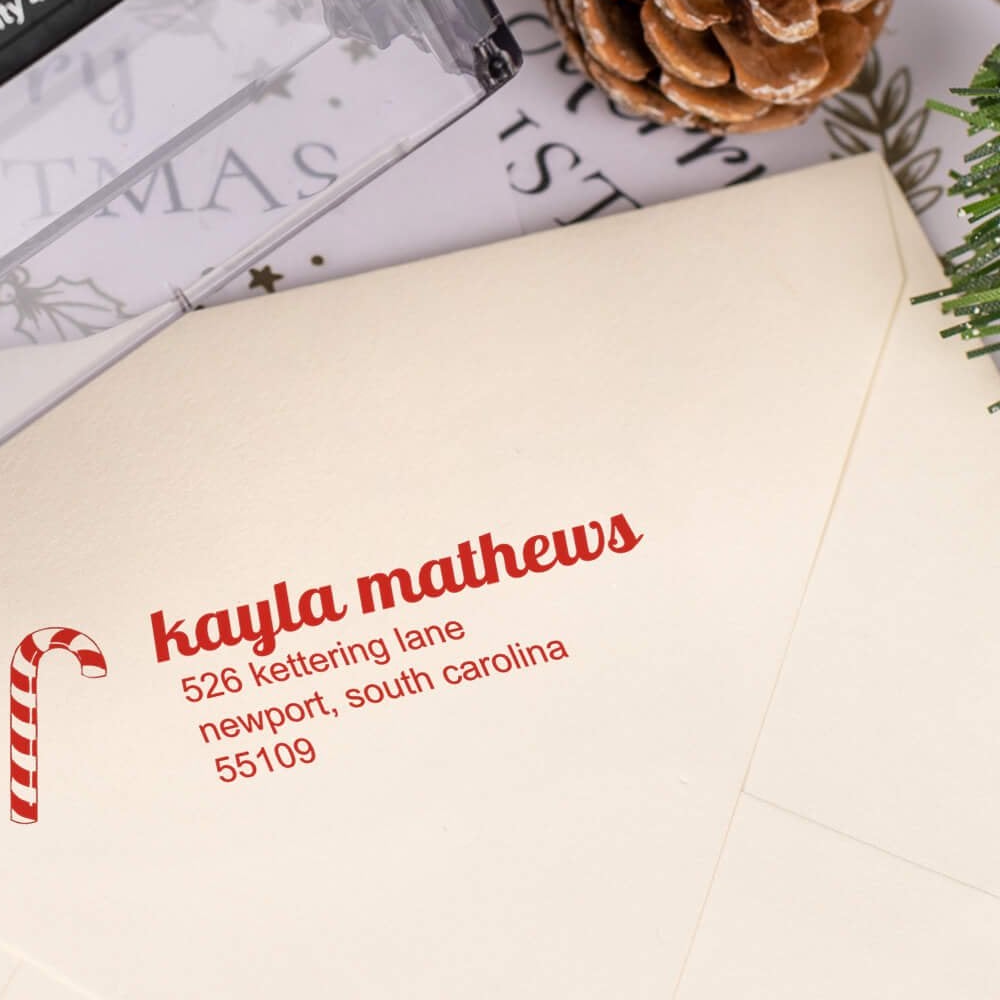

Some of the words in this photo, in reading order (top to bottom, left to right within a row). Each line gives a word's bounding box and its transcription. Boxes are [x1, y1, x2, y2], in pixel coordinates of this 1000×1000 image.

[150, 580, 349, 664] kayla
[356, 513, 645, 615] mathews
[181, 666, 243, 704] 526
[247, 637, 391, 687] kettering
[392, 620, 466, 653] lane
[199, 691, 339, 744] newport,
[344, 667, 435, 709] south
[442, 639, 569, 686] carolina
[214, 737, 317, 784] 55109
